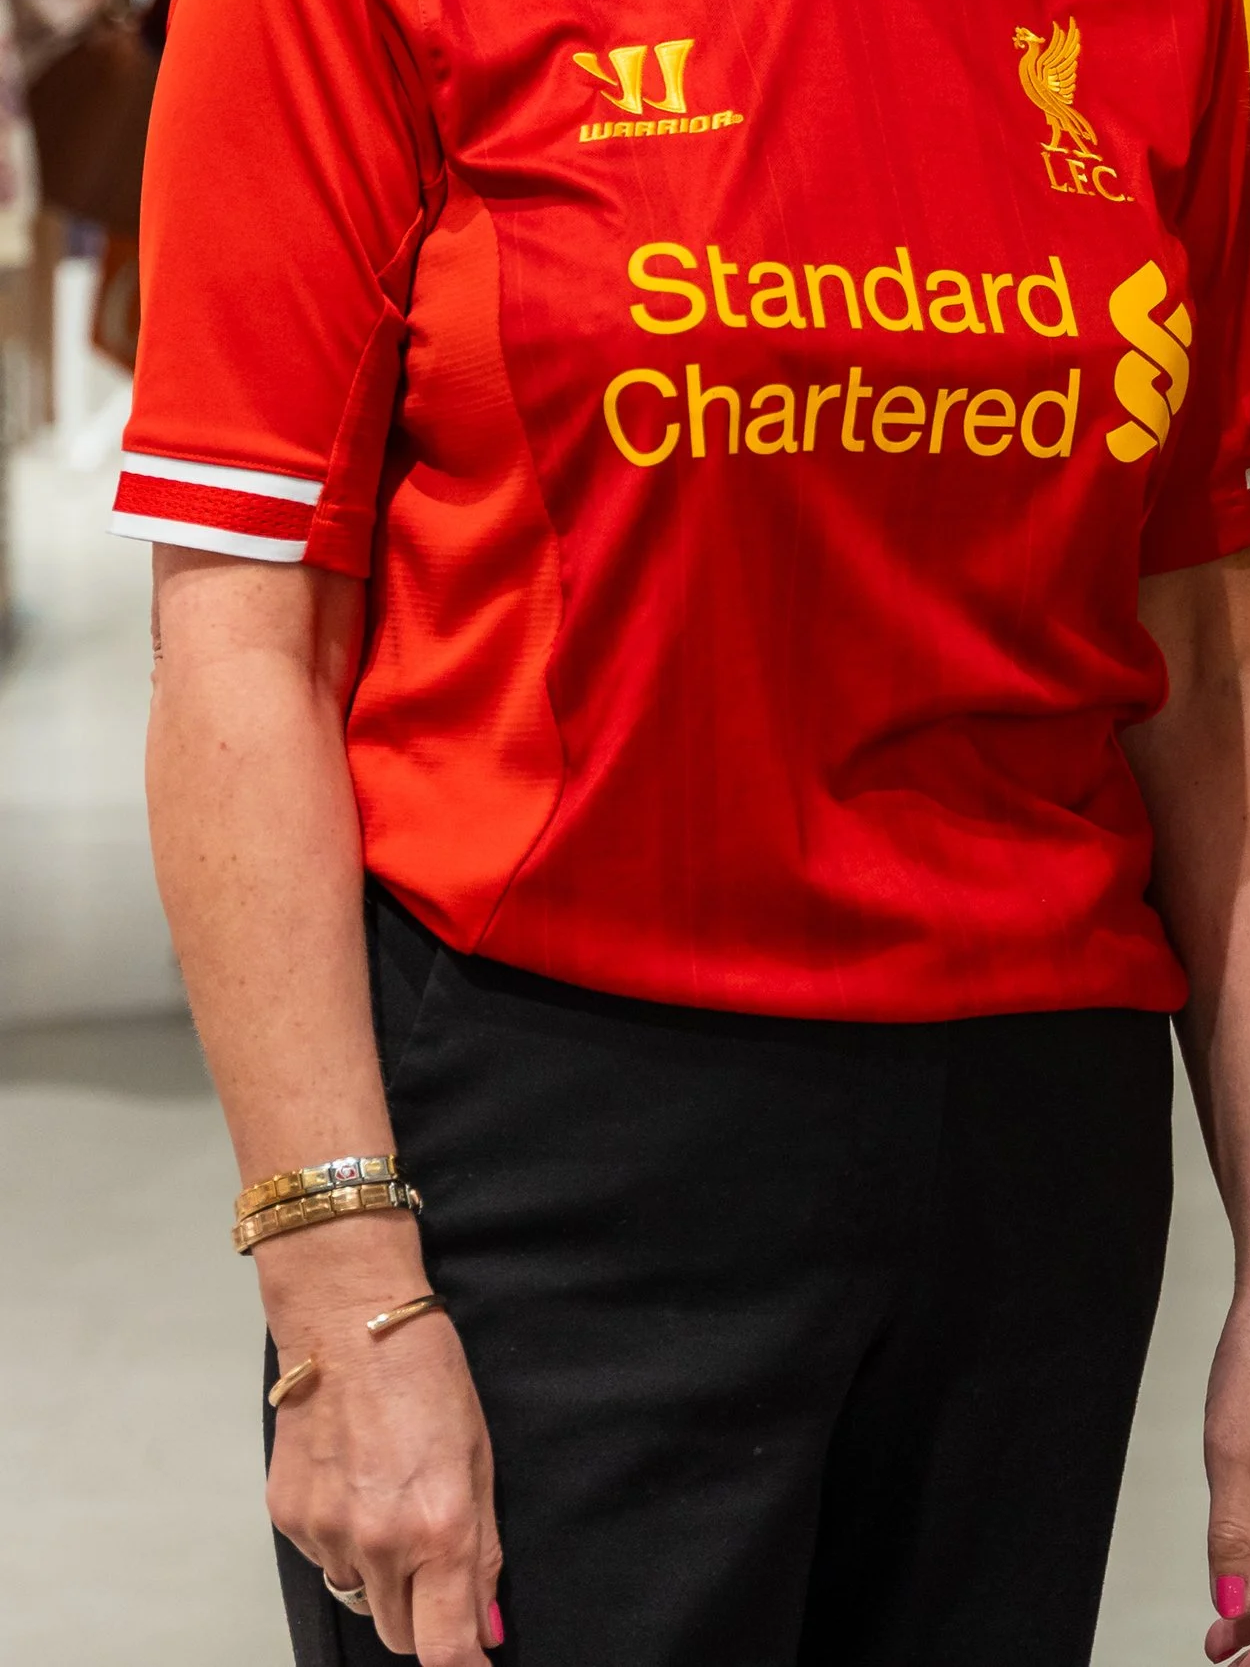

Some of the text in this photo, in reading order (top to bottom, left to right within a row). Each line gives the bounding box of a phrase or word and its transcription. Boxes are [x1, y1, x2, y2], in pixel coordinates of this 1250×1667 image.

[578, 109, 734, 143] WARRIOR
[1040, 151, 1135, 202] L.F.C.
[626, 241, 1080, 338] Standard
[602, 363, 1081, 468] Chartered
